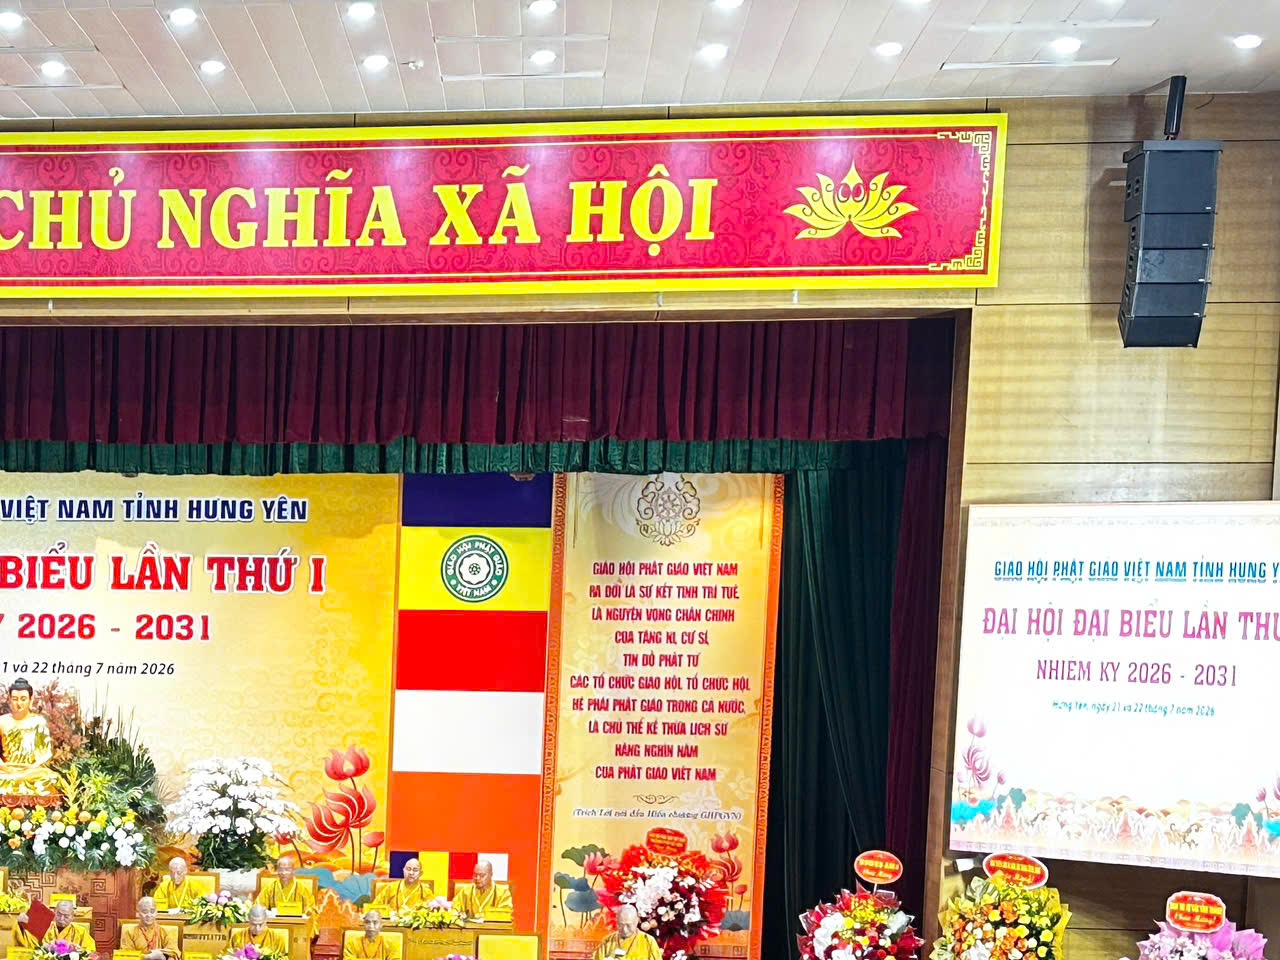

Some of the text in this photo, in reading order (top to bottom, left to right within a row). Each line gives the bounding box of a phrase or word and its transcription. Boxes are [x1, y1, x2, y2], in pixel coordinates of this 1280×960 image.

[157, 169, 407, 252] NGHĨA
[428, 165, 543, 249] XÃ
[565, 163, 719, 259] HỘI
[0, 495, 50, 522] VIỆT
[58, 500, 114, 518] NAM
[123, 492, 178, 519] TỈNH
[262, 496, 307, 520] YÊN
[111, 544, 190, 592] LẦN
[207, 549, 298, 592] THỨ
[311, 556, 326, 593] I
[1155, 562, 1187, 582] NAM
[18, 613, 95, 640] 2026
[135, 614, 209, 640] 2031
[13, 661, 28, 674] và
[32, 661, 48, 674] 22
[96, 662, 103, 674] 7
[141, 663, 175, 675] 2026
[1128, 662, 1171, 684] 2026
[1194, 664, 1235, 686] 2031
